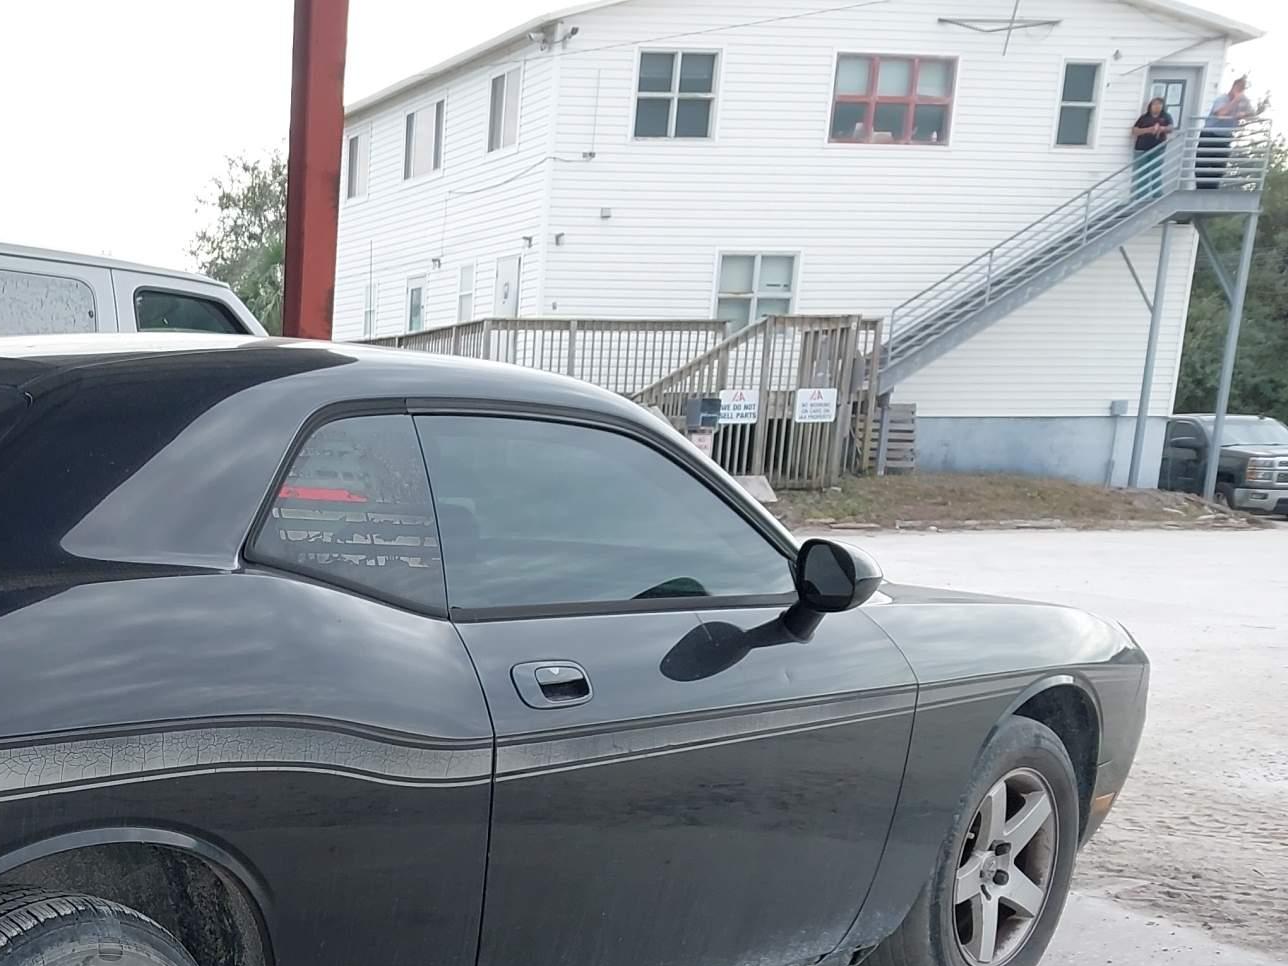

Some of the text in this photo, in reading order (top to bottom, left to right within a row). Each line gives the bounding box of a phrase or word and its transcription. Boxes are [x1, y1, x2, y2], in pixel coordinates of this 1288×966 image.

[733, 403, 742, 411] DO
[744, 403, 756, 411] NOT
[736, 411, 757, 419] PARTS
